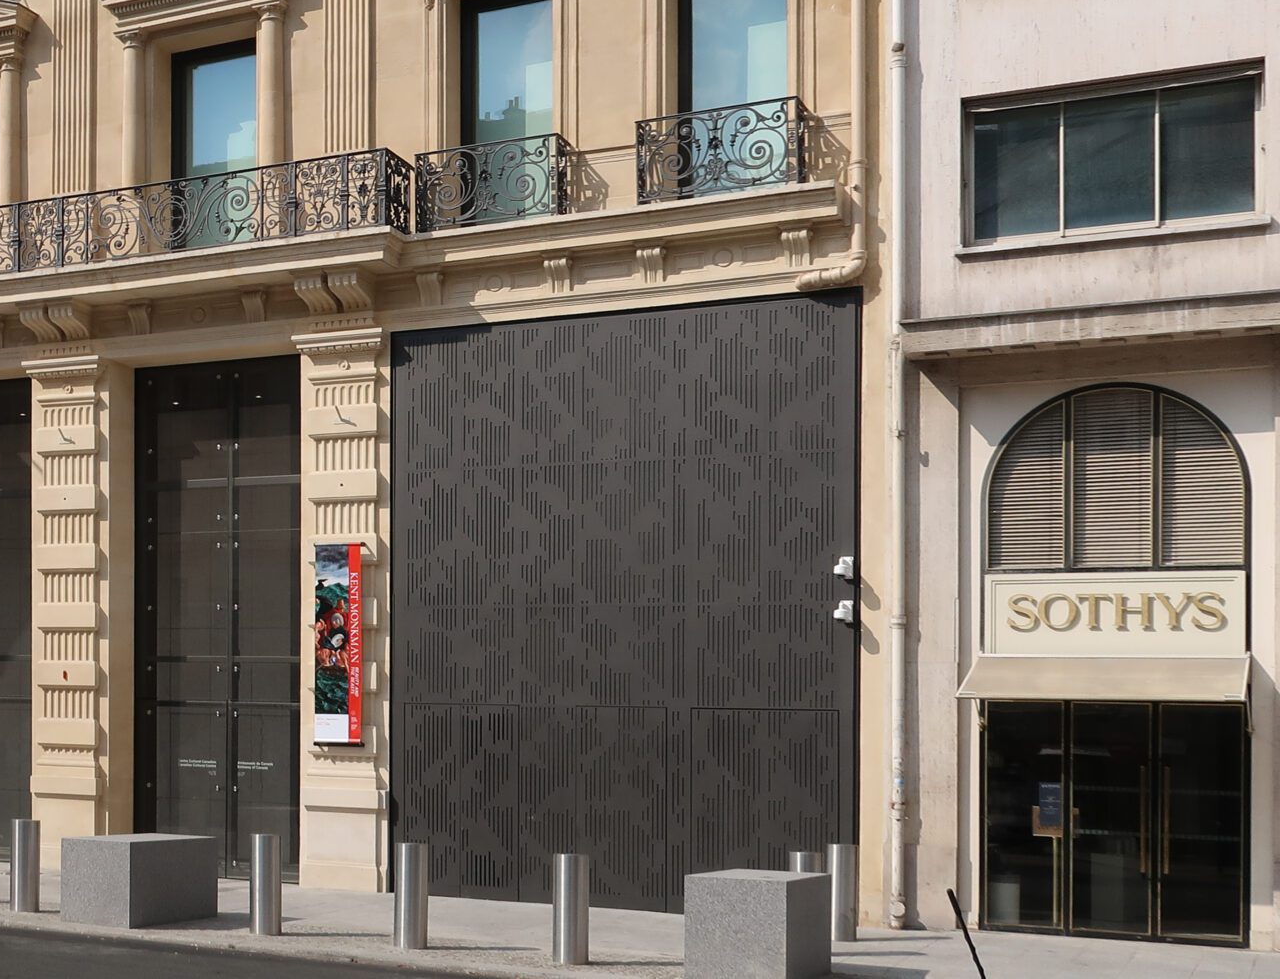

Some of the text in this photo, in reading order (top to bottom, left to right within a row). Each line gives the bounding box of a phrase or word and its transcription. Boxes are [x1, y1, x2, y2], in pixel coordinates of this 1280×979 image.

[350, 572, 360, 663] KENT MONKMAN
[1006, 591, 1228, 631] SOTHYS
